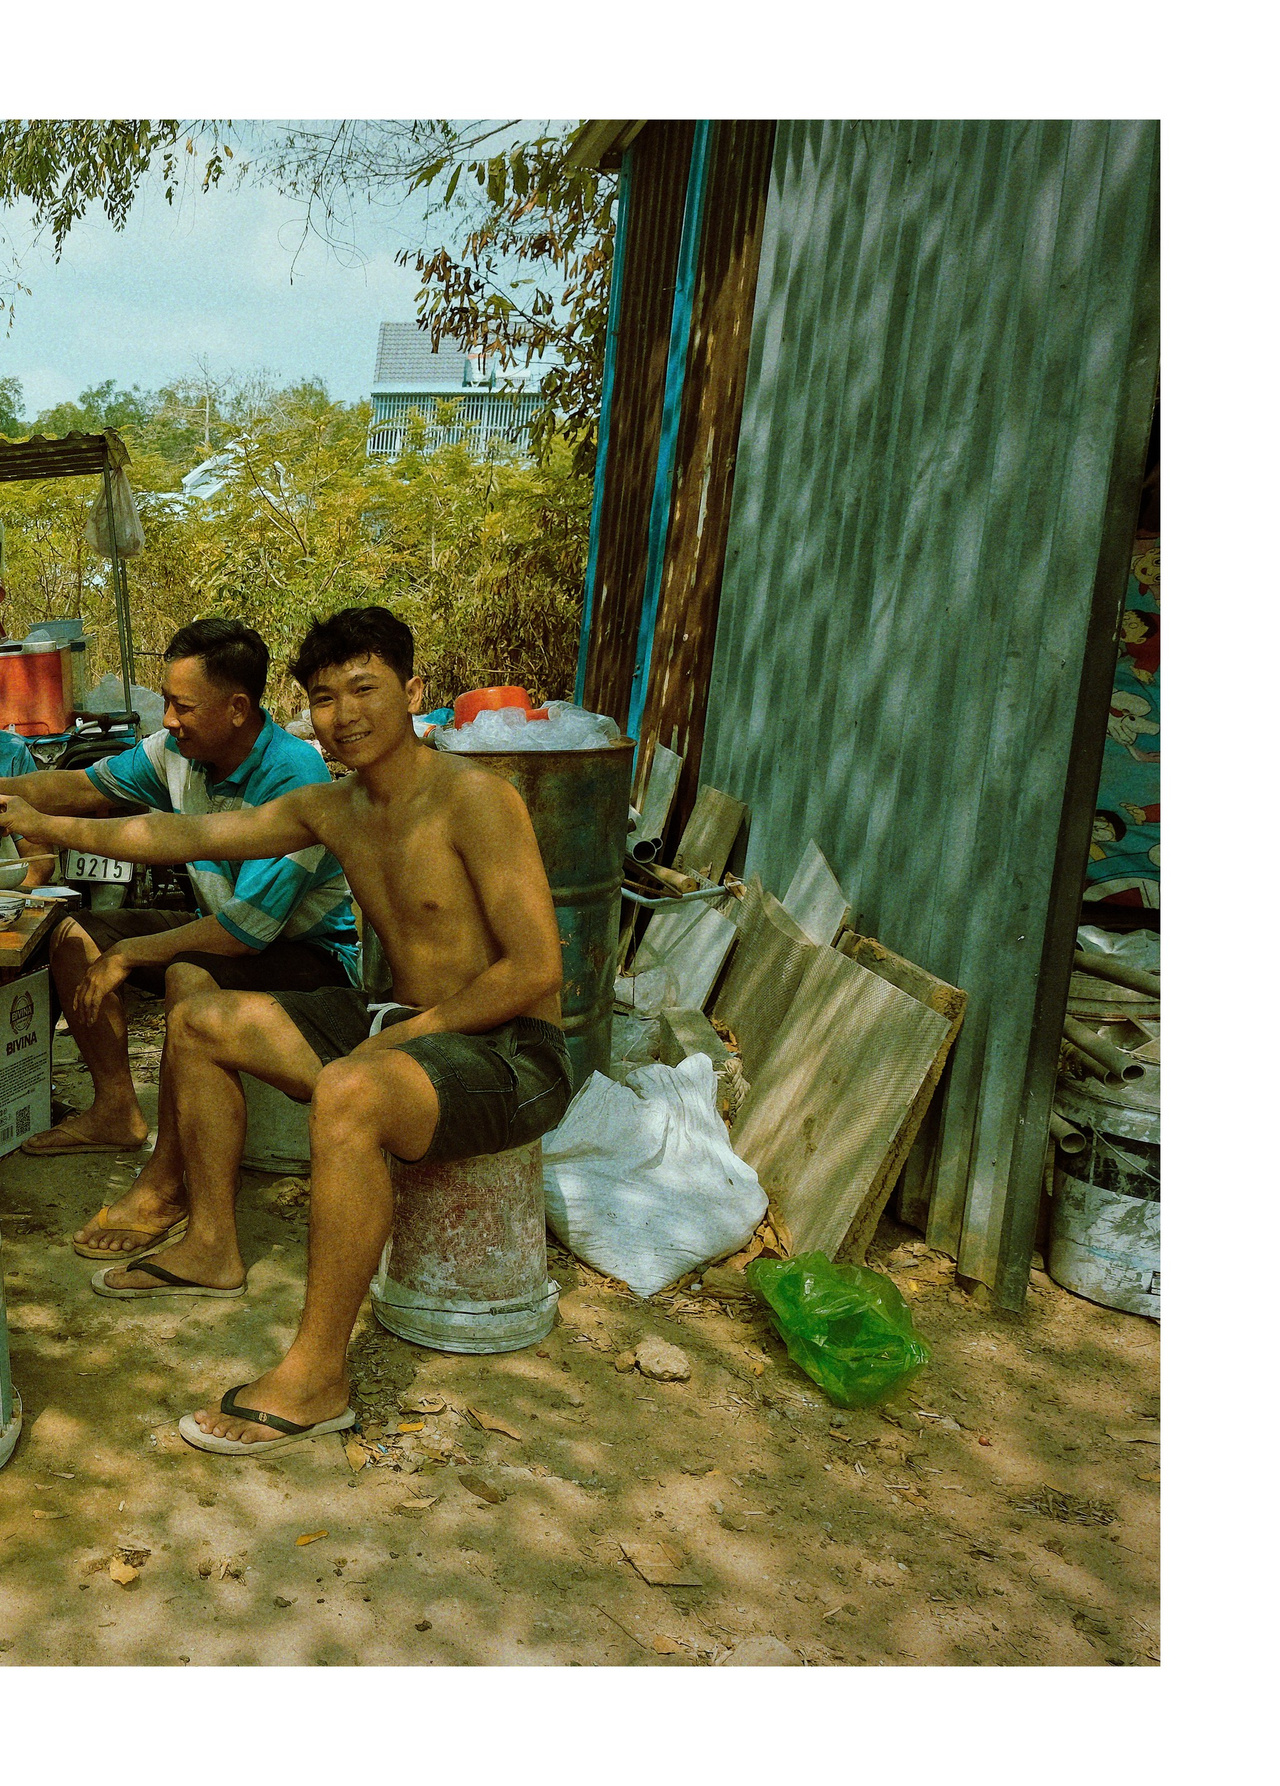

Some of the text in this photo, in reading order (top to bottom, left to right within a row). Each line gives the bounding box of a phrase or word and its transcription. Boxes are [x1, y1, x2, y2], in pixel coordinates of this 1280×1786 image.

[75, 857, 123, 879] 9215
[11, 1005, 33, 1020] BIVINA
[6, 1031, 38, 1056] BIVINA
